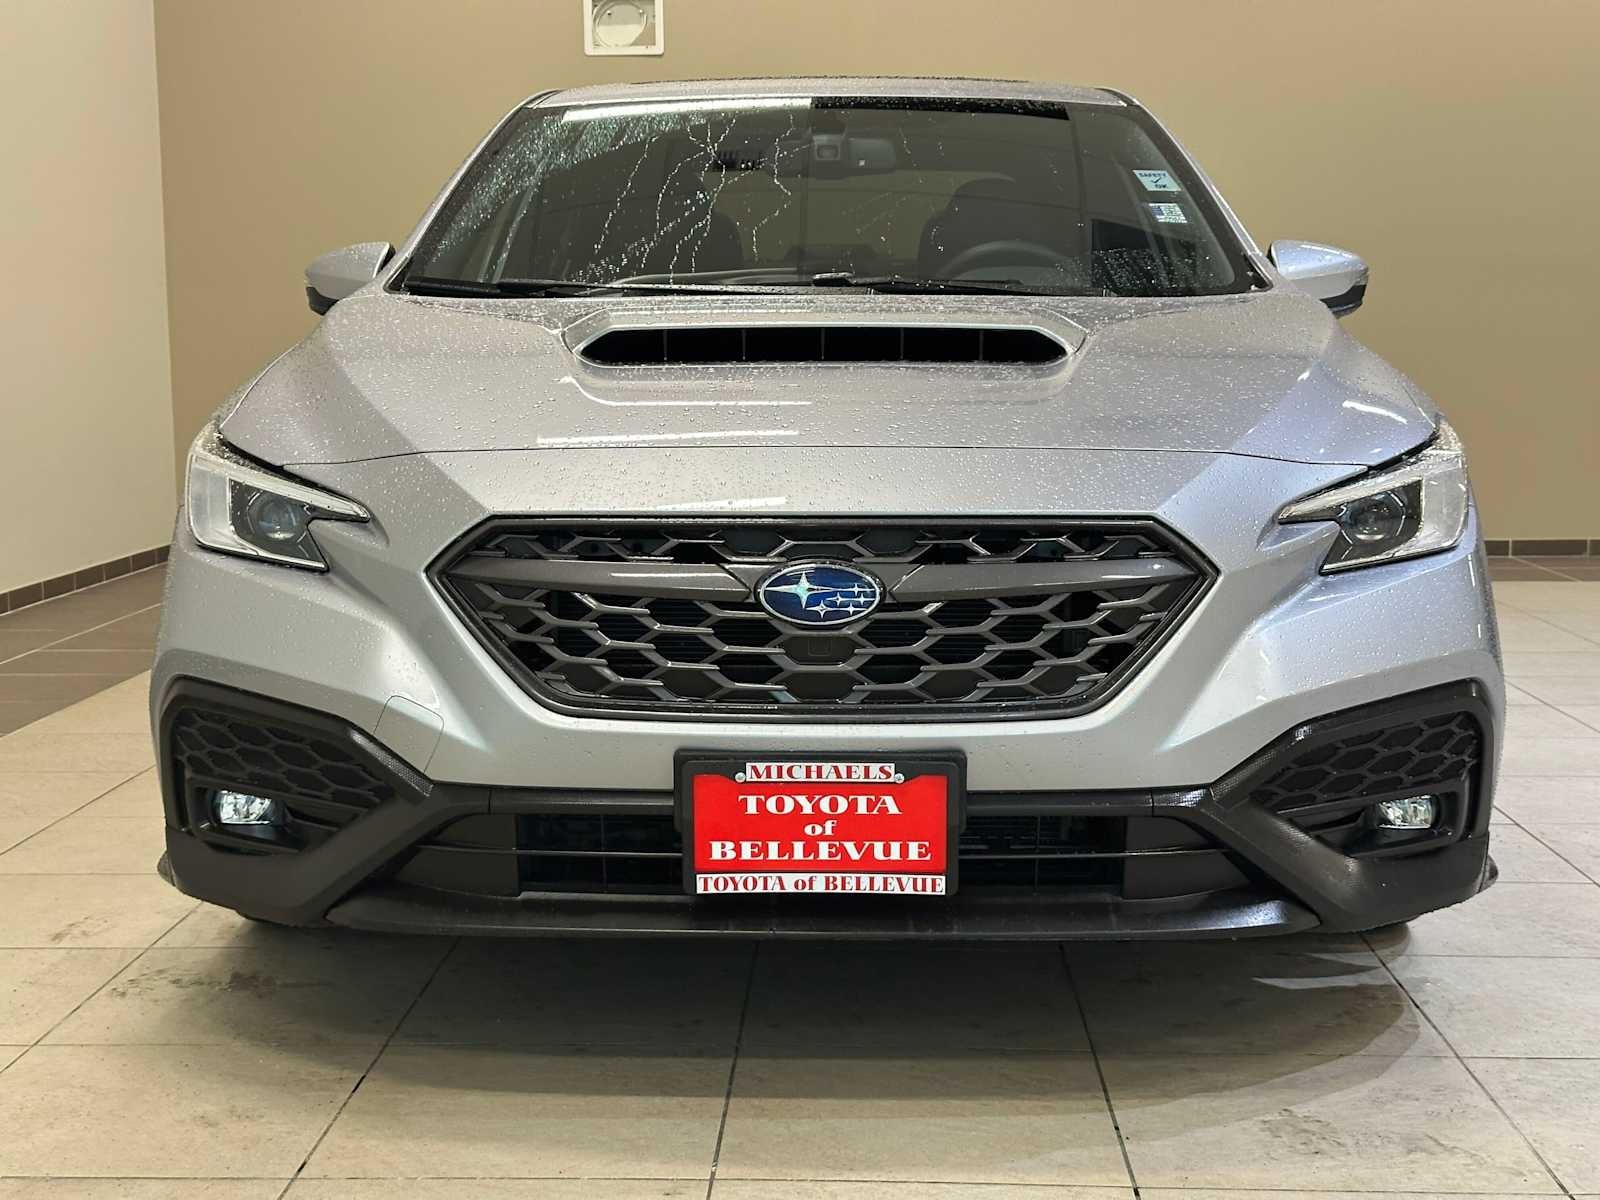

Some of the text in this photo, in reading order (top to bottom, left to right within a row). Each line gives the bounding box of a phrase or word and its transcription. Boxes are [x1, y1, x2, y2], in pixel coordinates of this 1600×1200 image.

[750, 764, 893, 780] MICHAELS
[738, 794, 902, 815] TOYOTA
[803, 819, 837, 836] of
[709, 840, 932, 861] BELLEVUE
[698, 875, 944, 893] TOYOTA of BELLEVUE
